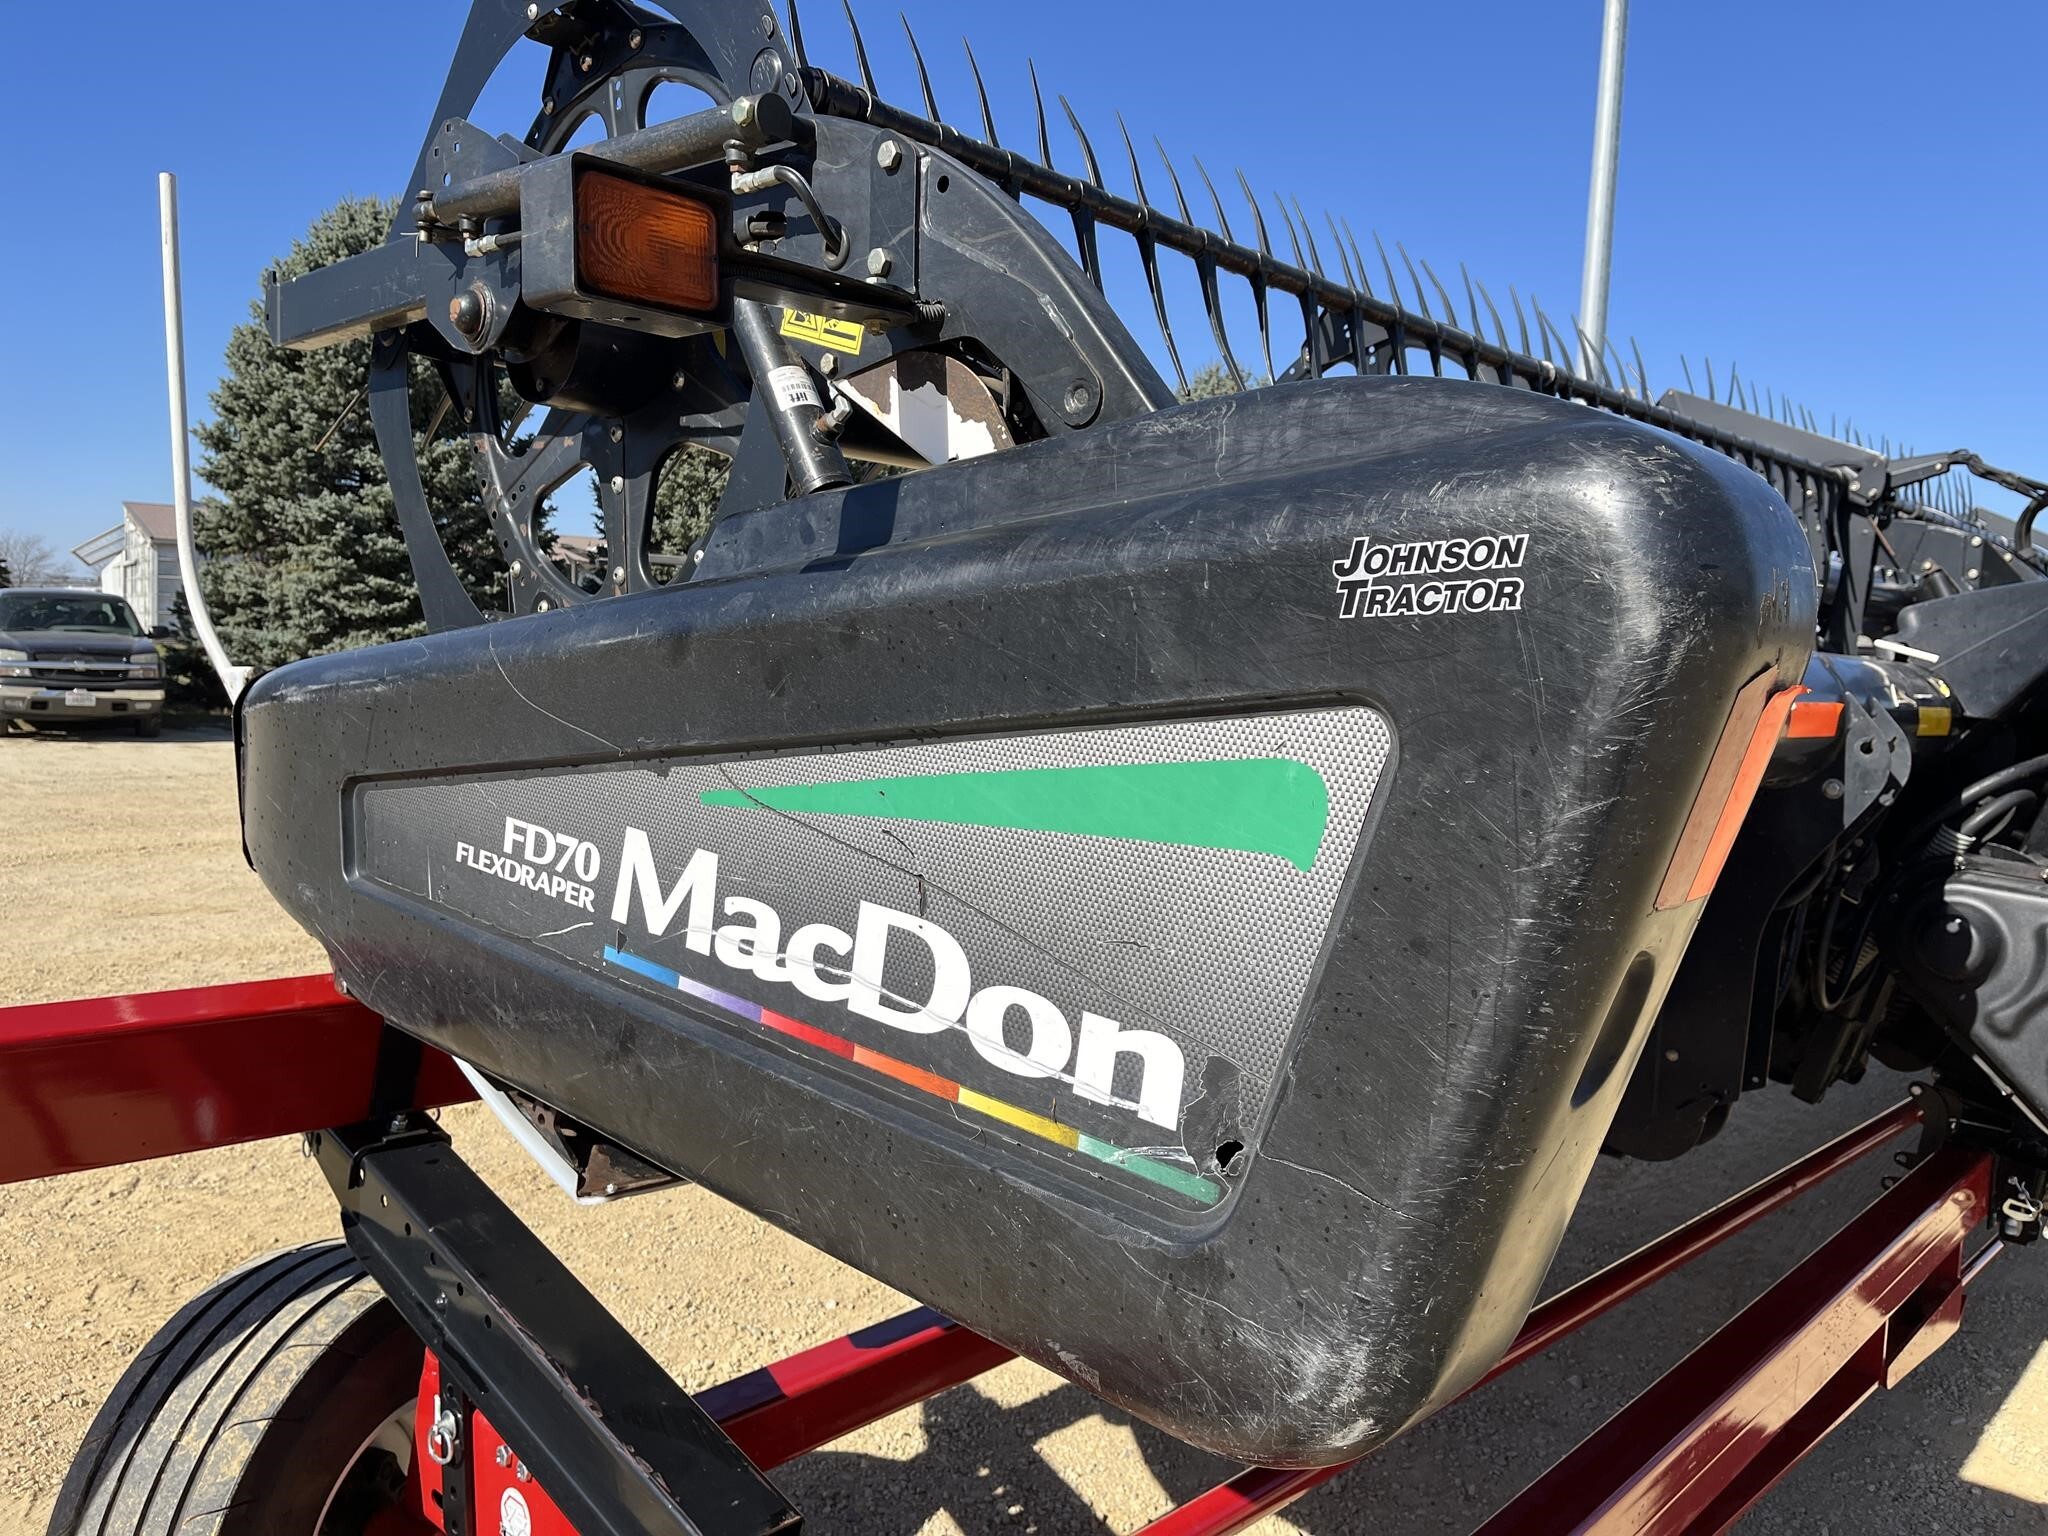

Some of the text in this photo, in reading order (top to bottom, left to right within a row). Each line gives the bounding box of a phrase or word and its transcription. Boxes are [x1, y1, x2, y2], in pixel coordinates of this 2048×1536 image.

[1333, 534, 1529, 579] JOHNSON
[1336, 578, 1524, 618] TRACTOR
[455, 841, 595, 913] FLEXDRAPER
[503, 816, 601, 882] FD70
[611, 826, 1186, 1131] MacDon
